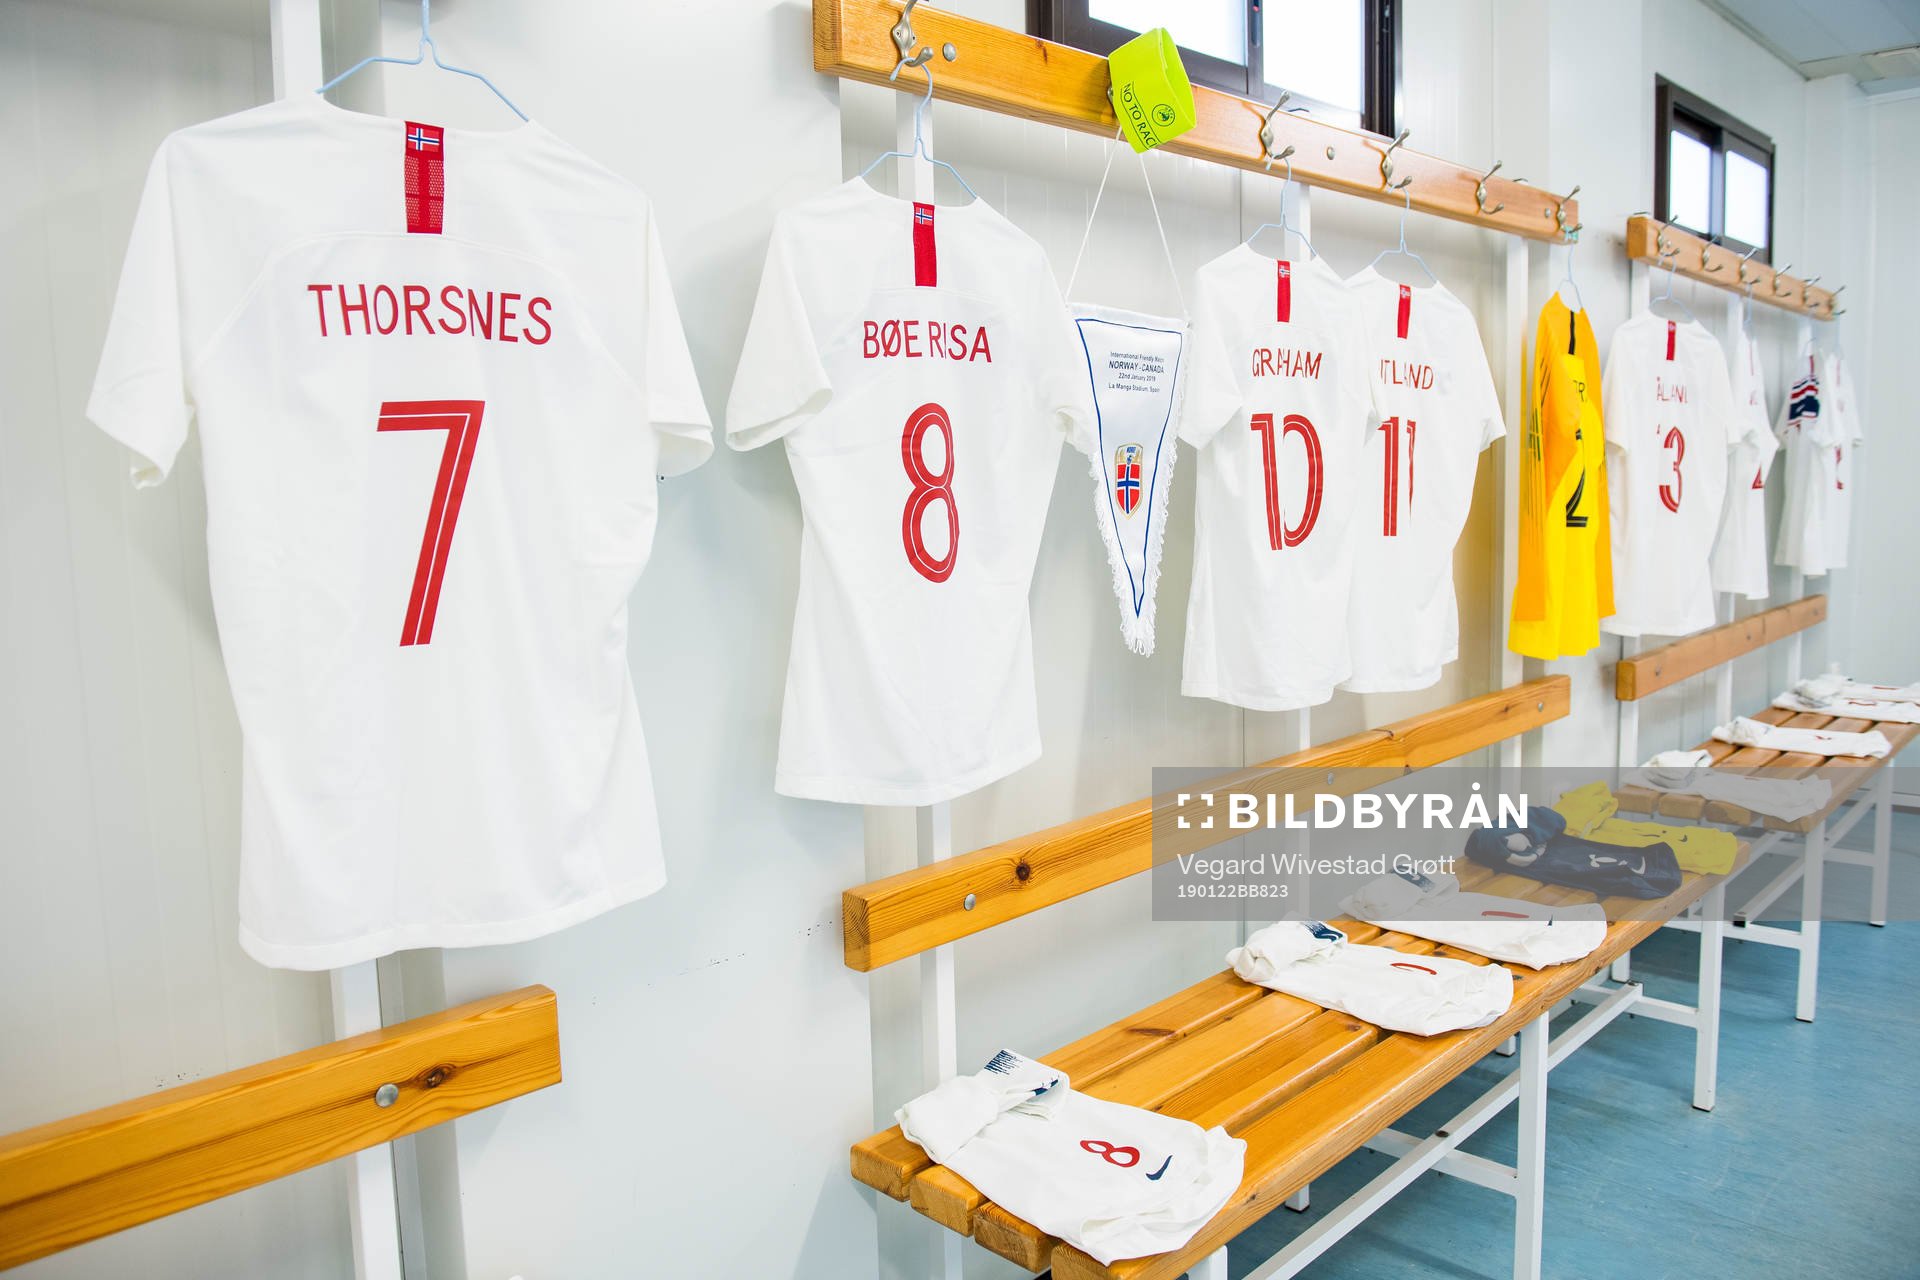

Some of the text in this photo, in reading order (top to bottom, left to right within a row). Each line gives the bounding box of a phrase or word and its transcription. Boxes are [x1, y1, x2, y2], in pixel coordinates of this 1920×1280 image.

[1123, 83, 1133, 103] NO
[1129, 104, 1141, 120] TO
[307, 283, 552, 345] THORSNES
[863, 319, 992, 363] BØE RISA
[1110, 352, 1138, 360] International
[1139, 353, 1154, 363] Friendly
[1109, 360, 1138, 370] NORWAY
[1142, 363, 1165, 374] CANADA
[1118, 372, 1131, 380] 22nd
[1131, 373, 1146, 382] January
[1252, 347, 1323, 380] GRAHAM
[1116, 383, 1131, 391] Manga
[901, 402, 960, 583] 8
[1250, 413, 1324, 550] 10
[376, 400, 486, 647] 7
[1080, 1140, 1140, 1168] 8
